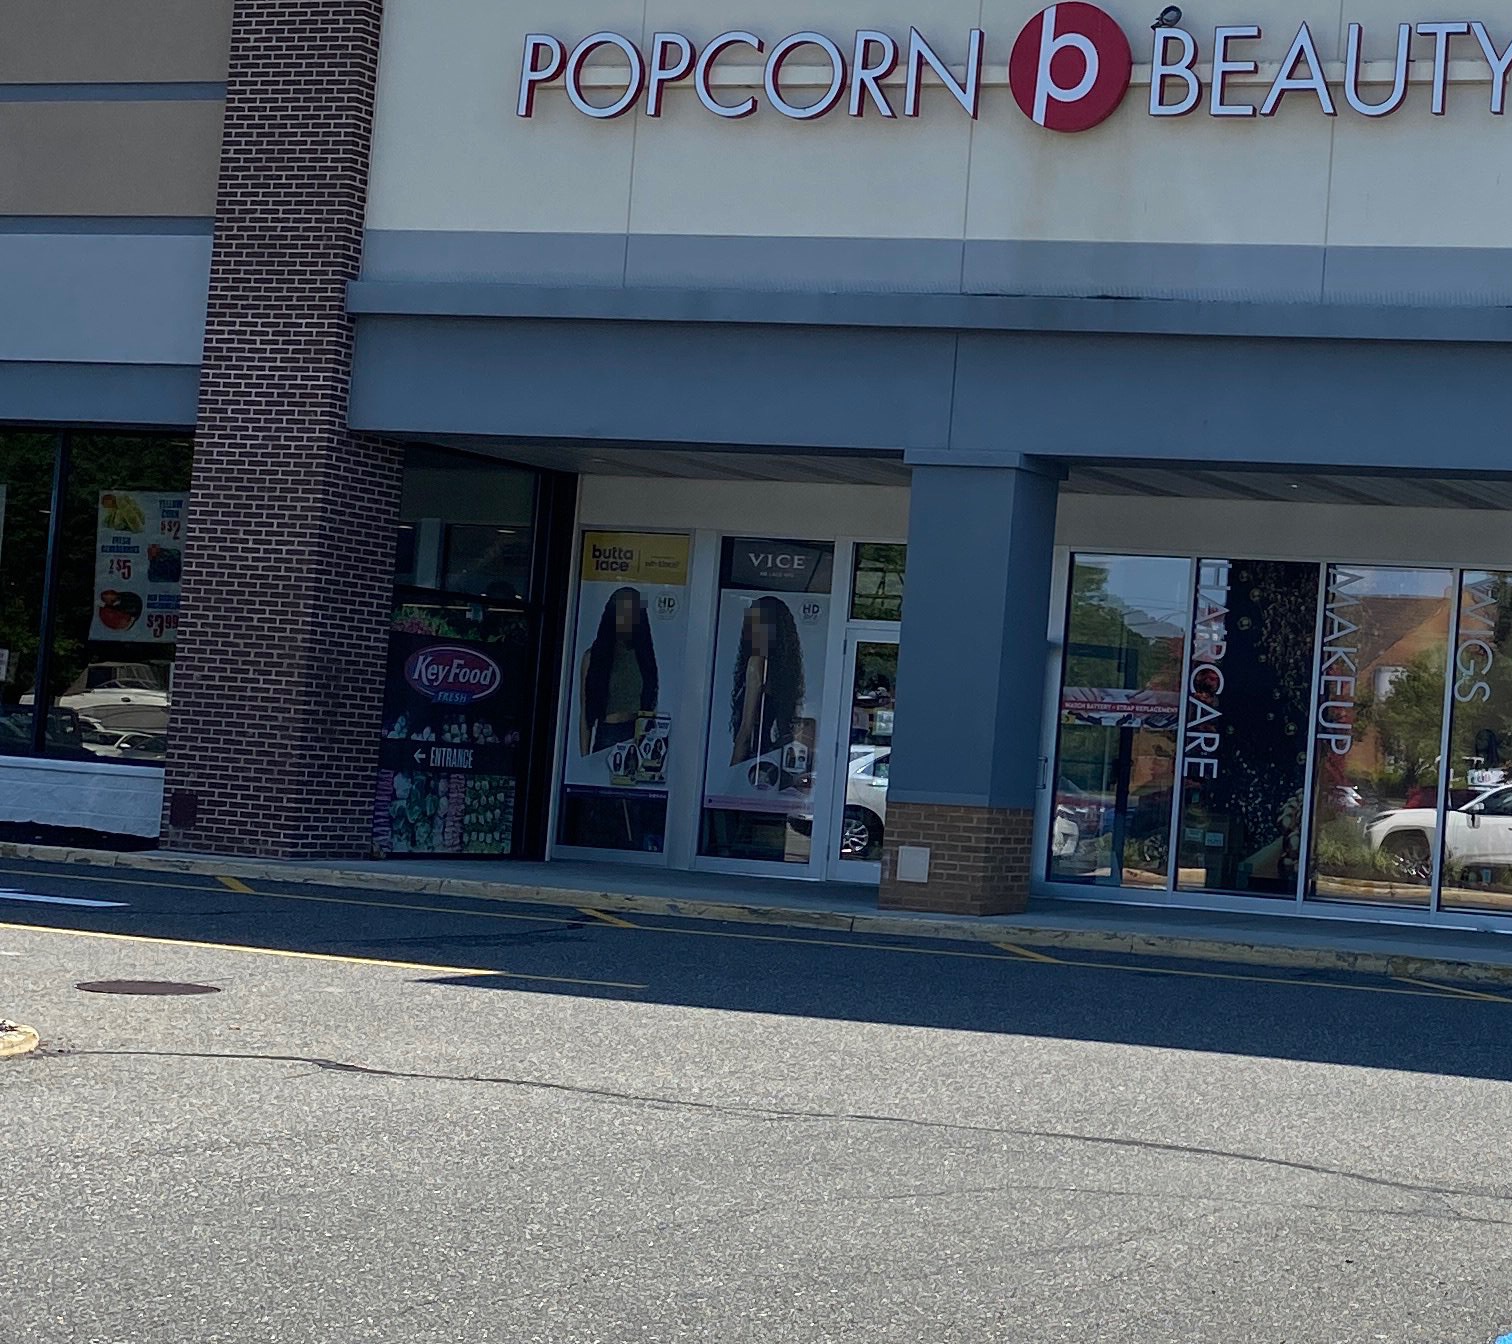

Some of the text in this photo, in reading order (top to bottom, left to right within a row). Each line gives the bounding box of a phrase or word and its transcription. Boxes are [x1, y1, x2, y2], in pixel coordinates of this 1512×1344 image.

[516, 26, 984, 120] POPCORN
[592, 544, 633, 560] butta
[749, 553, 806, 569] VICE
[116, 559, 132, 580] $5
[595, 560, 629, 572] lace
[658, 597, 676, 608] HD
[803, 604, 819, 615] HD
[1454, 575, 1499, 703] WIGS
[1184, 562, 1232, 779] HAIRCARE
[1317, 567, 1367, 756] MAKEUP
[437, 692, 467, 703] FRESH
[430, 747, 474, 768] ENTRANCE
